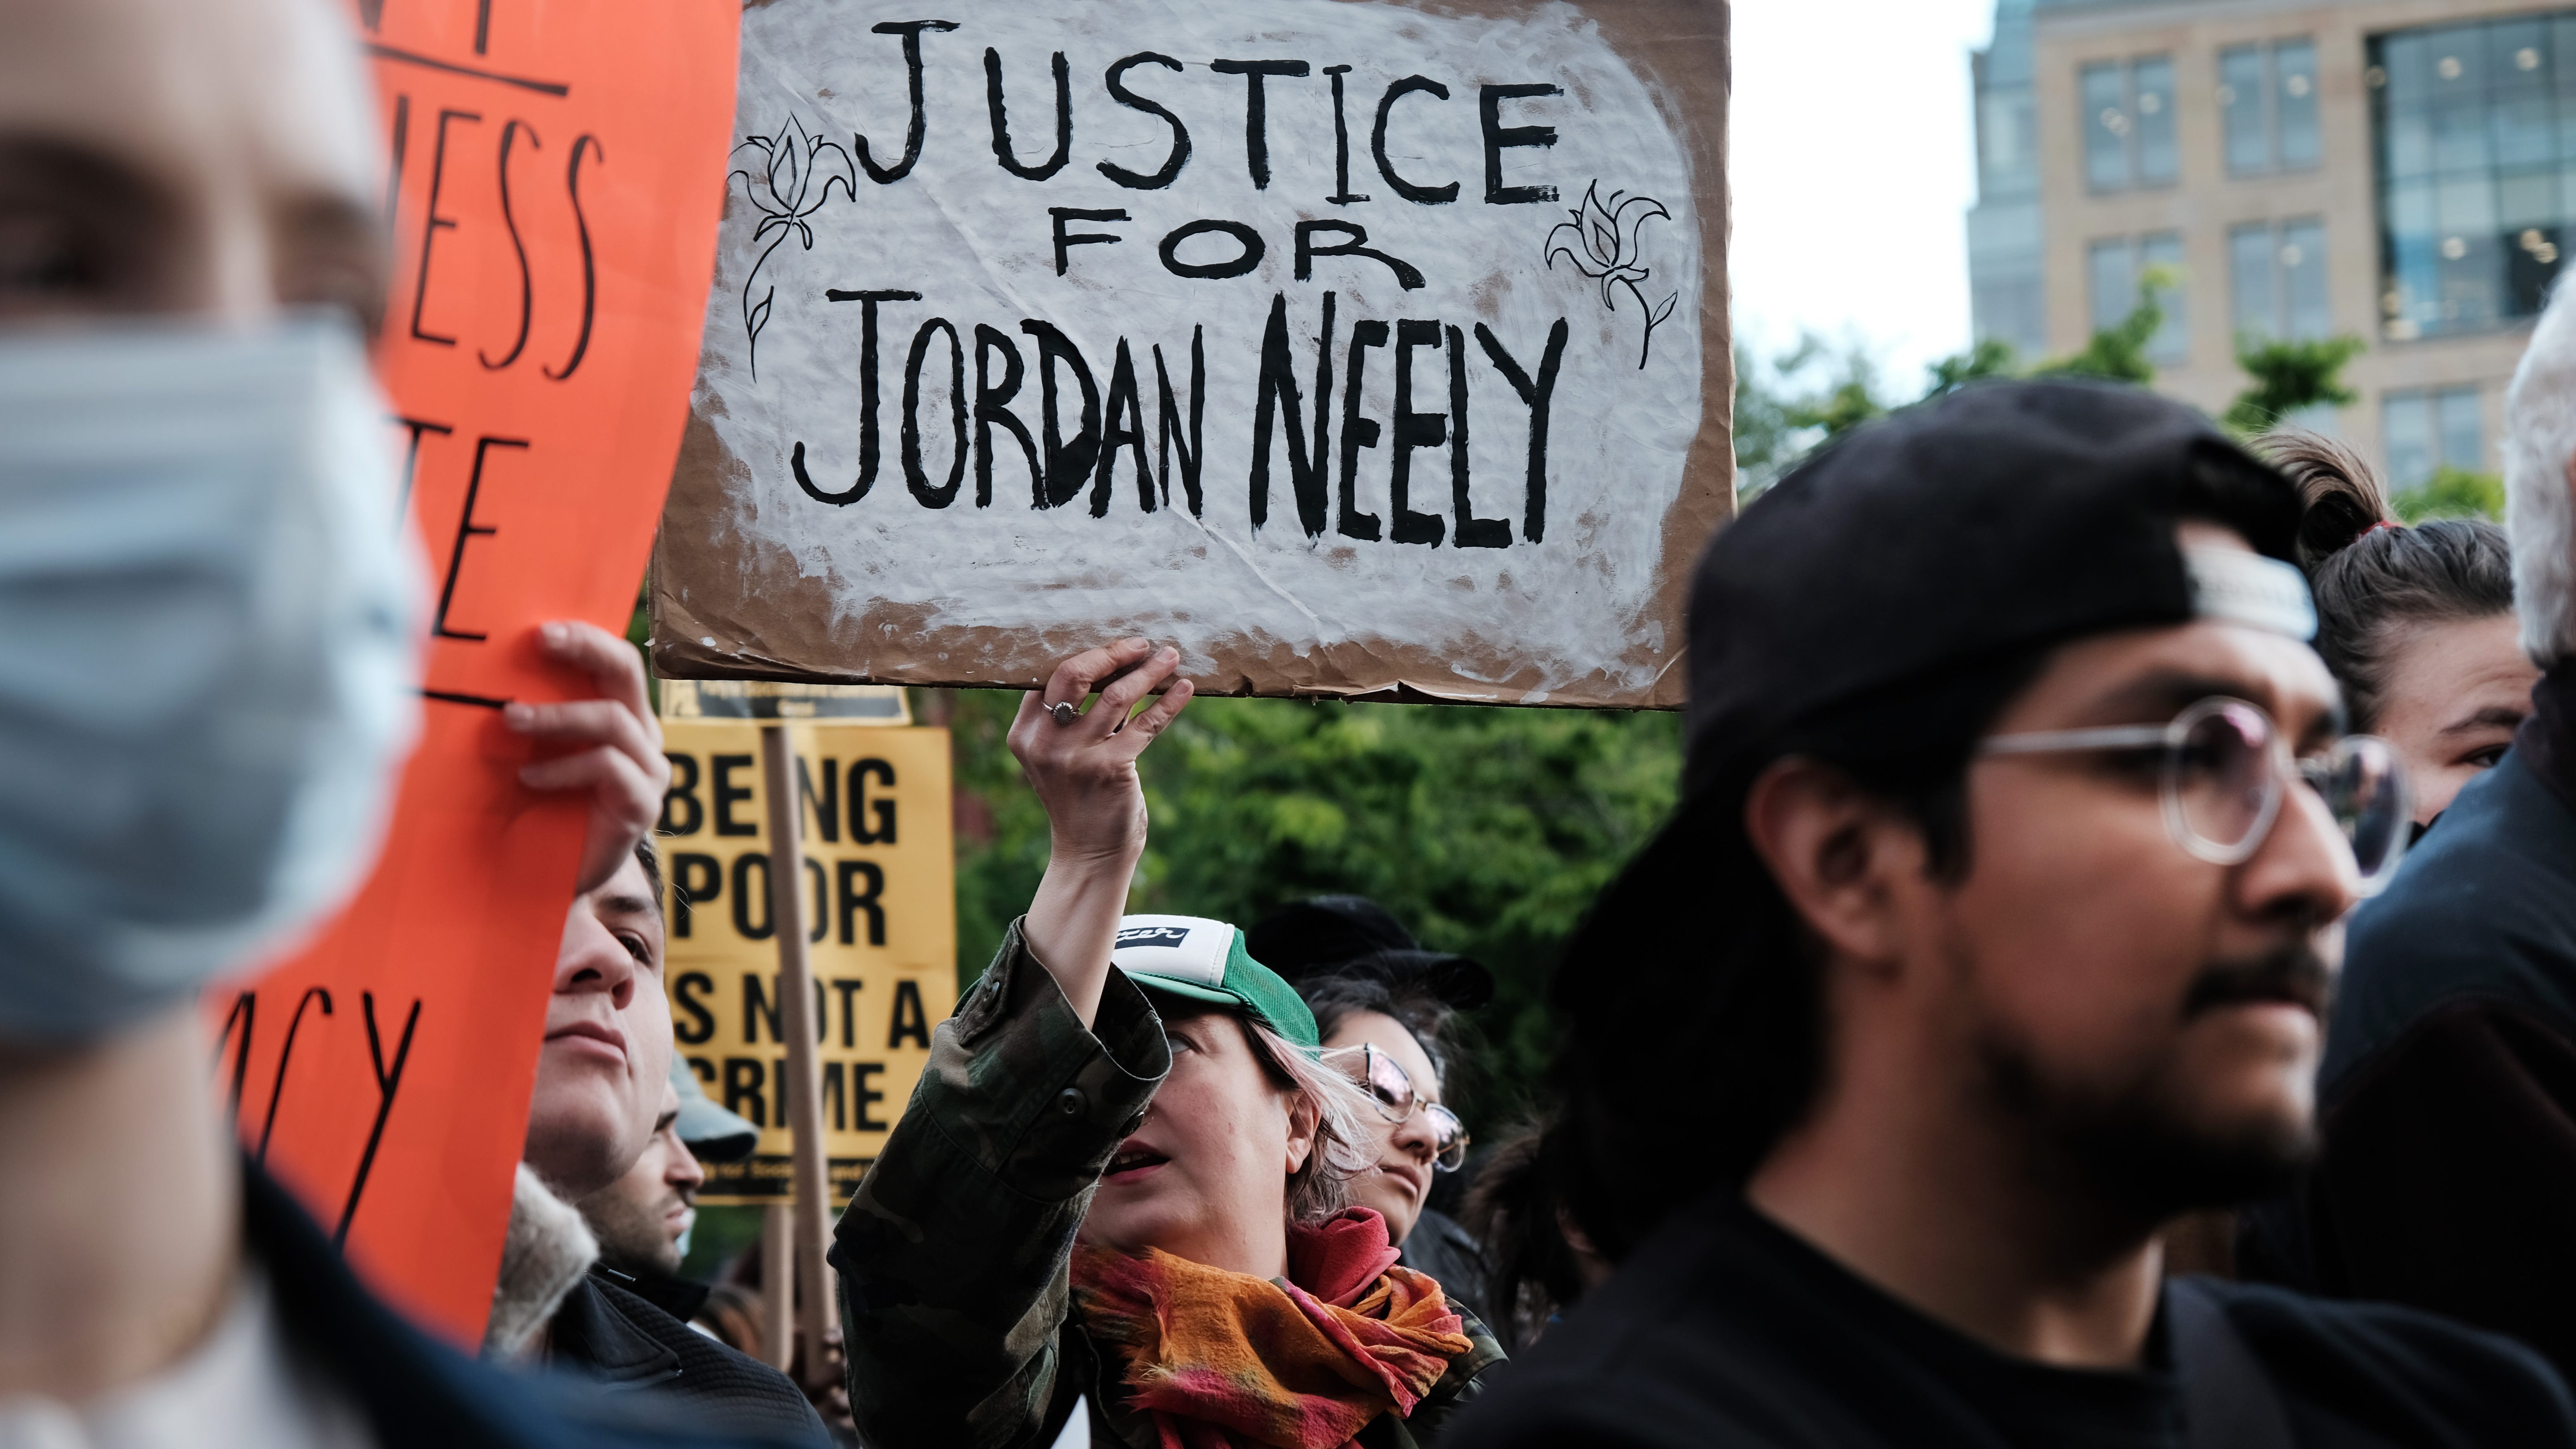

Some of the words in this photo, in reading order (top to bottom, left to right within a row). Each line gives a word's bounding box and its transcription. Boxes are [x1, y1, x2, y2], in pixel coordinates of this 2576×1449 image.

[855, 20, 1564, 206] JUSTICE
[1048, 207, 1426, 291] FOR
[790, 288, 1205, 519] JORDAN
[1249, 291, 1568, 549] NEELY
[389, 416, 529, 640] TE
[658, 753, 897, 845] BENG
[673, 972, 715, 1044] S
[889, 980, 930, 1049] A
